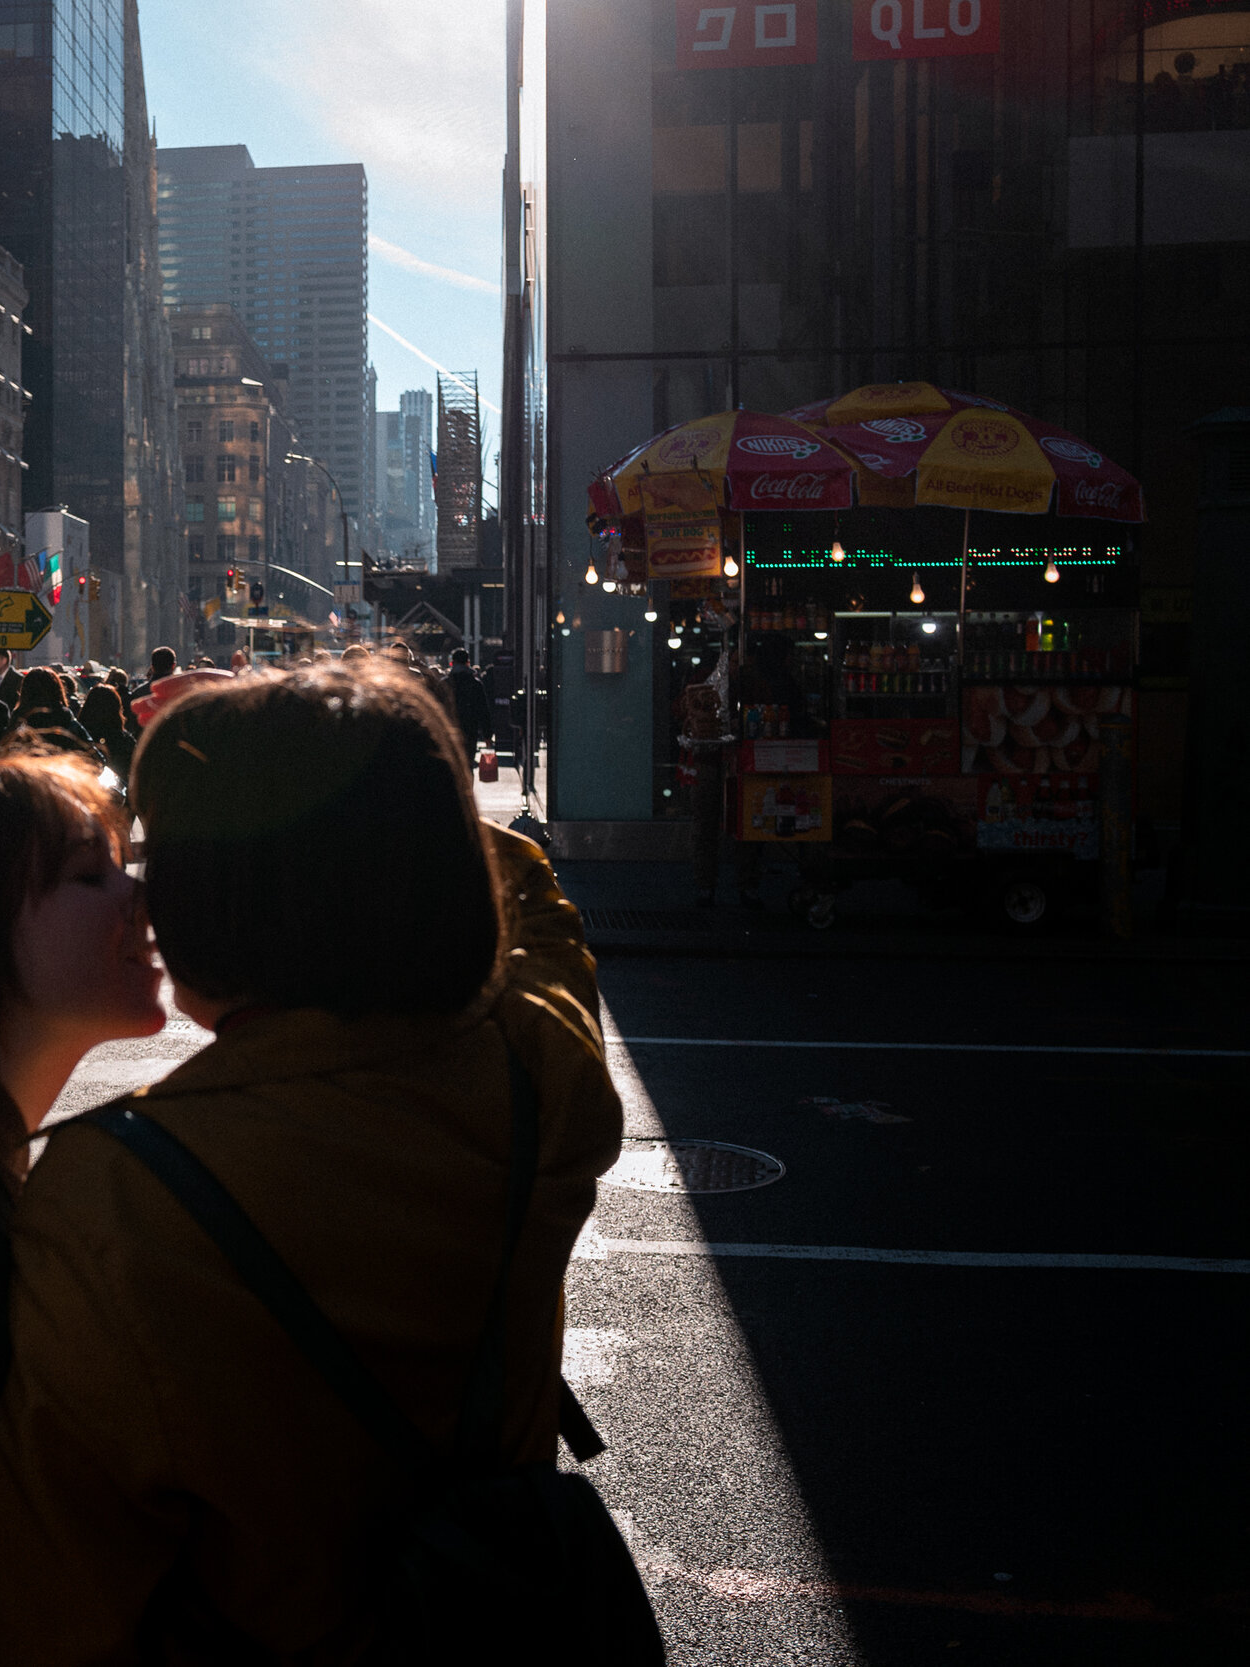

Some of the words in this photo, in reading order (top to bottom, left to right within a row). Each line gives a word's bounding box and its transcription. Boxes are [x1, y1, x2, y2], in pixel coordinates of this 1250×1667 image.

[870, 0, 982, 49] QLO
[746, 438, 800, 452] NIKAS
[925, 479, 943, 492] All
[946, 480, 977, 494] Beef
[980, 483, 1003, 497] Hot
[1006, 485, 1043, 502] Dogs
[661, 528, 680, 537] HOT
[683, 527, 704, 537] DOG
[1014, 831, 1088, 848] thirsty?
